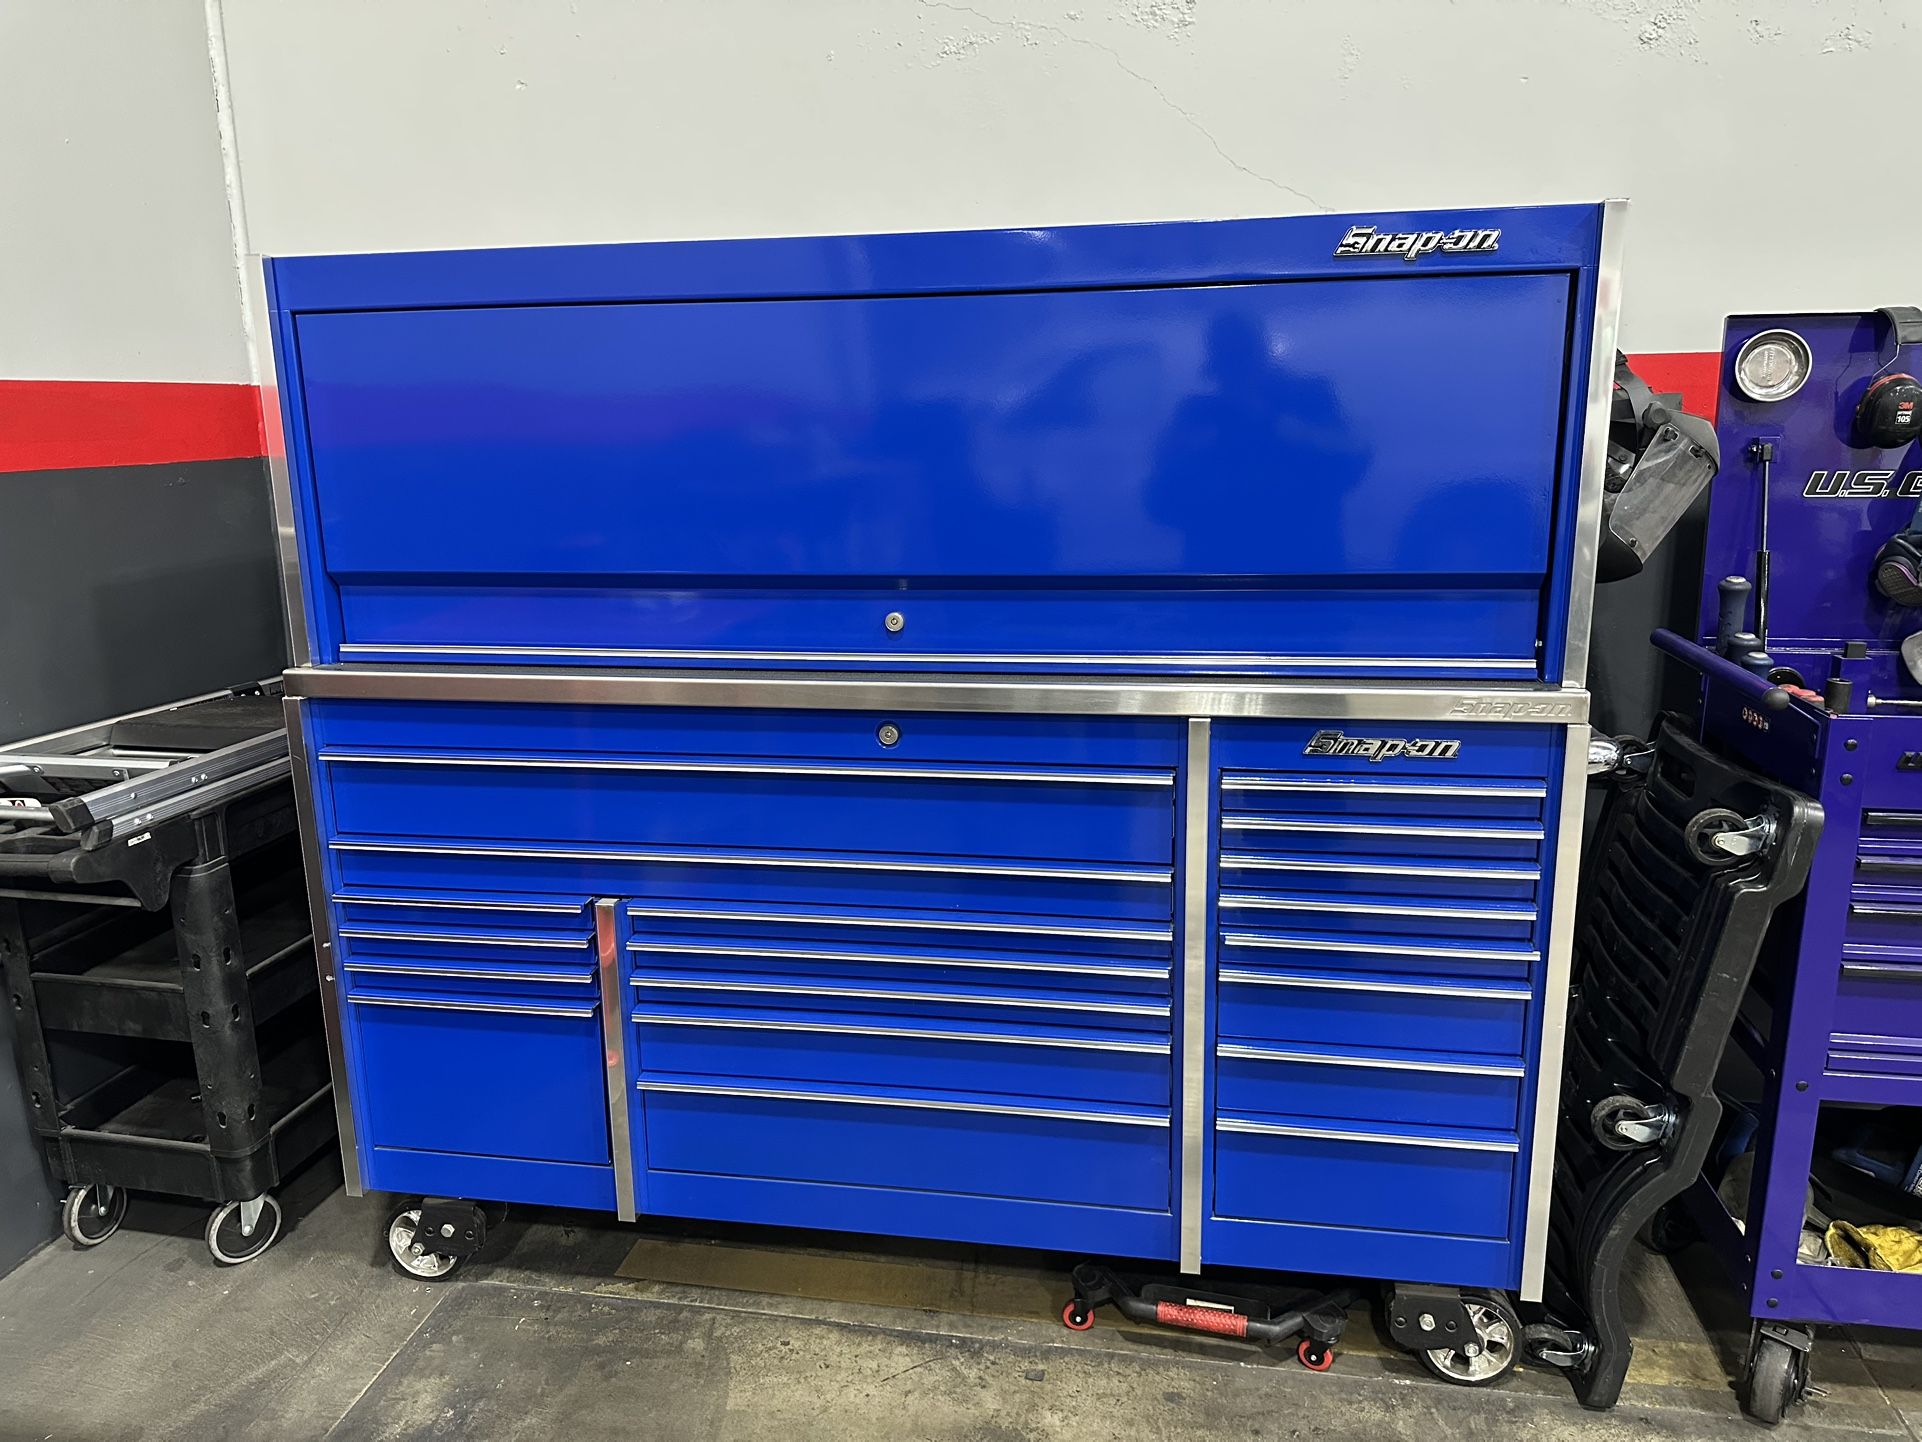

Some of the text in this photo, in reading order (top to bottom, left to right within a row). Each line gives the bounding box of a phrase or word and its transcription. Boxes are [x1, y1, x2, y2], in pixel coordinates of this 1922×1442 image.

[1333, 225, 1501, 260] Snap-on
[1898, 402, 1914, 410] 3M
[1896, 415, 1911, 423] 105
[1449, 697, 1572, 720] Snap-on
[1303, 730, 1461, 762] Snap-on
